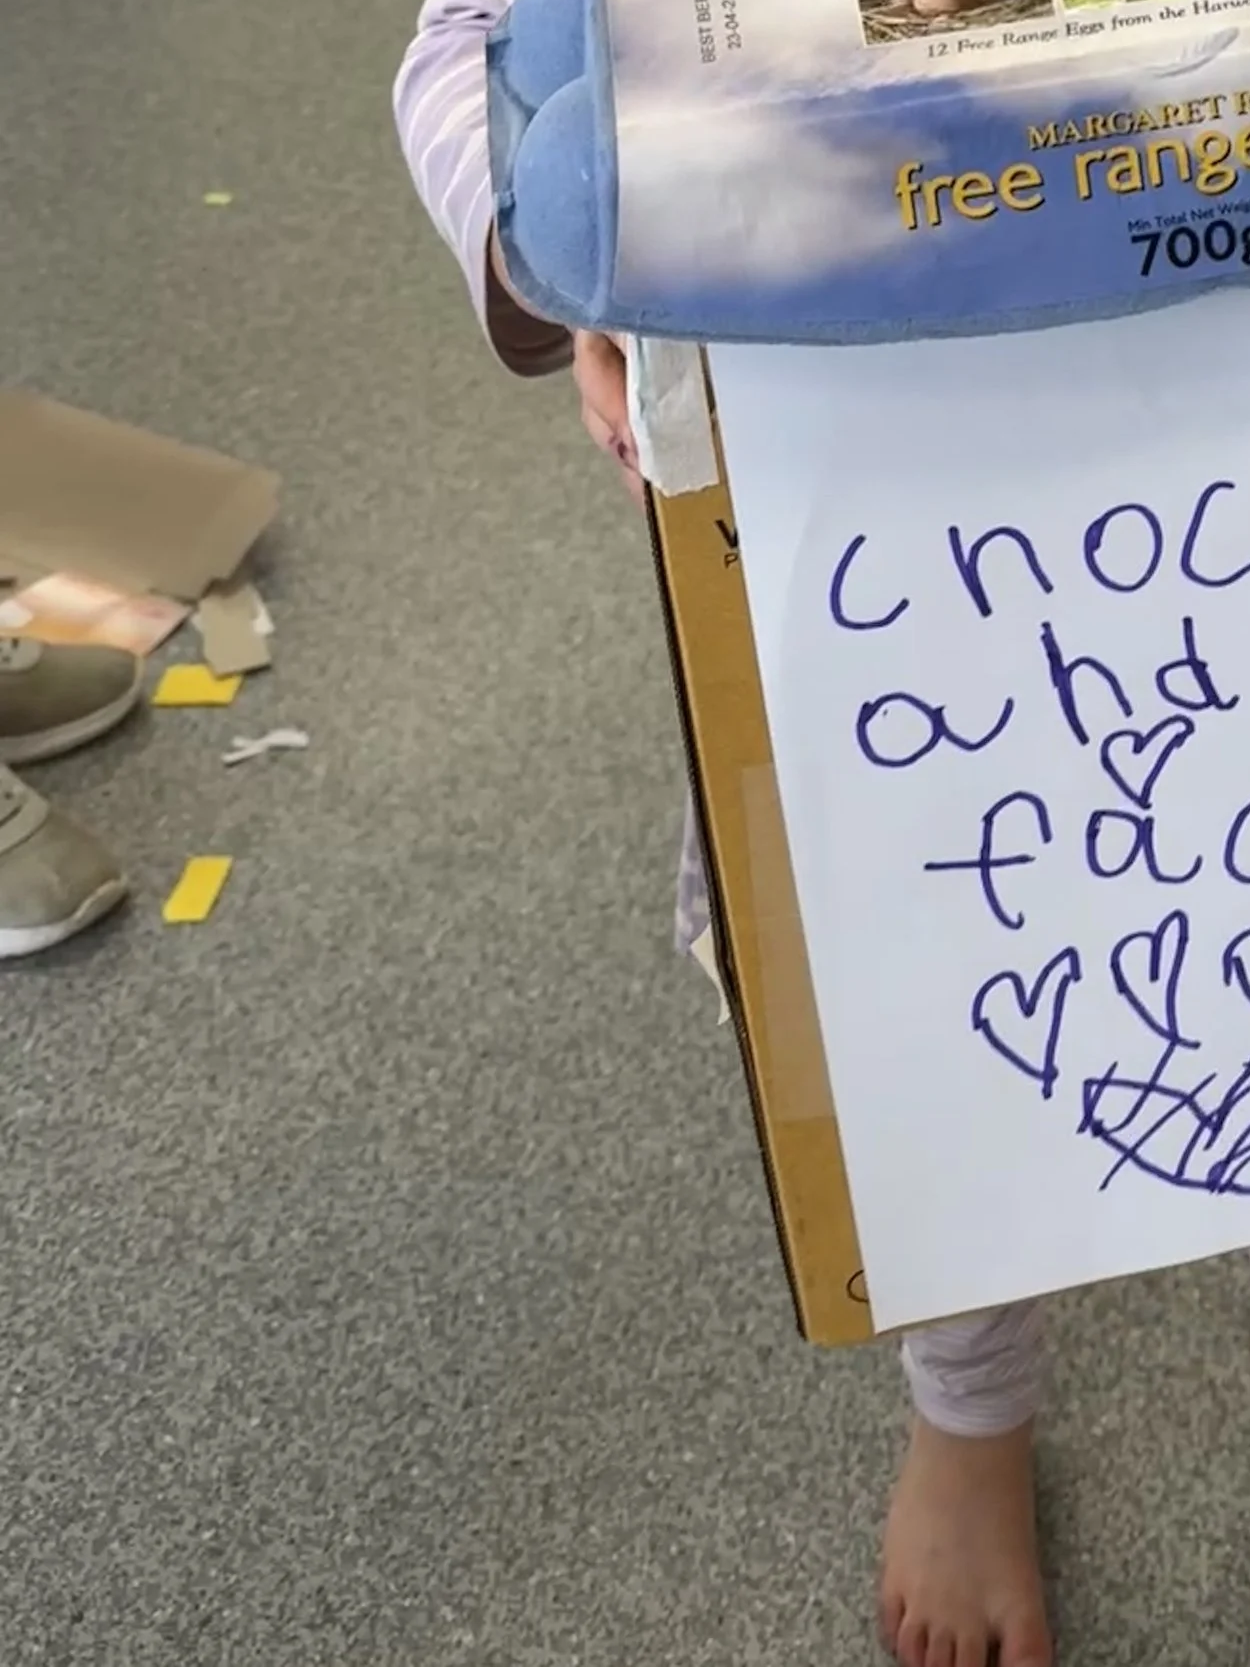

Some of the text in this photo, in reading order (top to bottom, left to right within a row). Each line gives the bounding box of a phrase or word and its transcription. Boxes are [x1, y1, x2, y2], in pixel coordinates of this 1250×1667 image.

[698, 27, 717, 64] BEST
[926, 43, 949, 59] 12
[956, 38, 996, 54] Free
[1002, 29, 1059, 47] Range
[1066, 20, 1106, 37] Eggs
[1110, 14, 1152, 32] from
[1159, 6, 1186, 22] the
[1027, 94, 1228, 152] MARGARET
[894, 159, 1046, 231] free
[1127, 219, 1152, 233] Min
[1154, 211, 1188, 228] Total
[1190, 207, 1215, 222] Net
